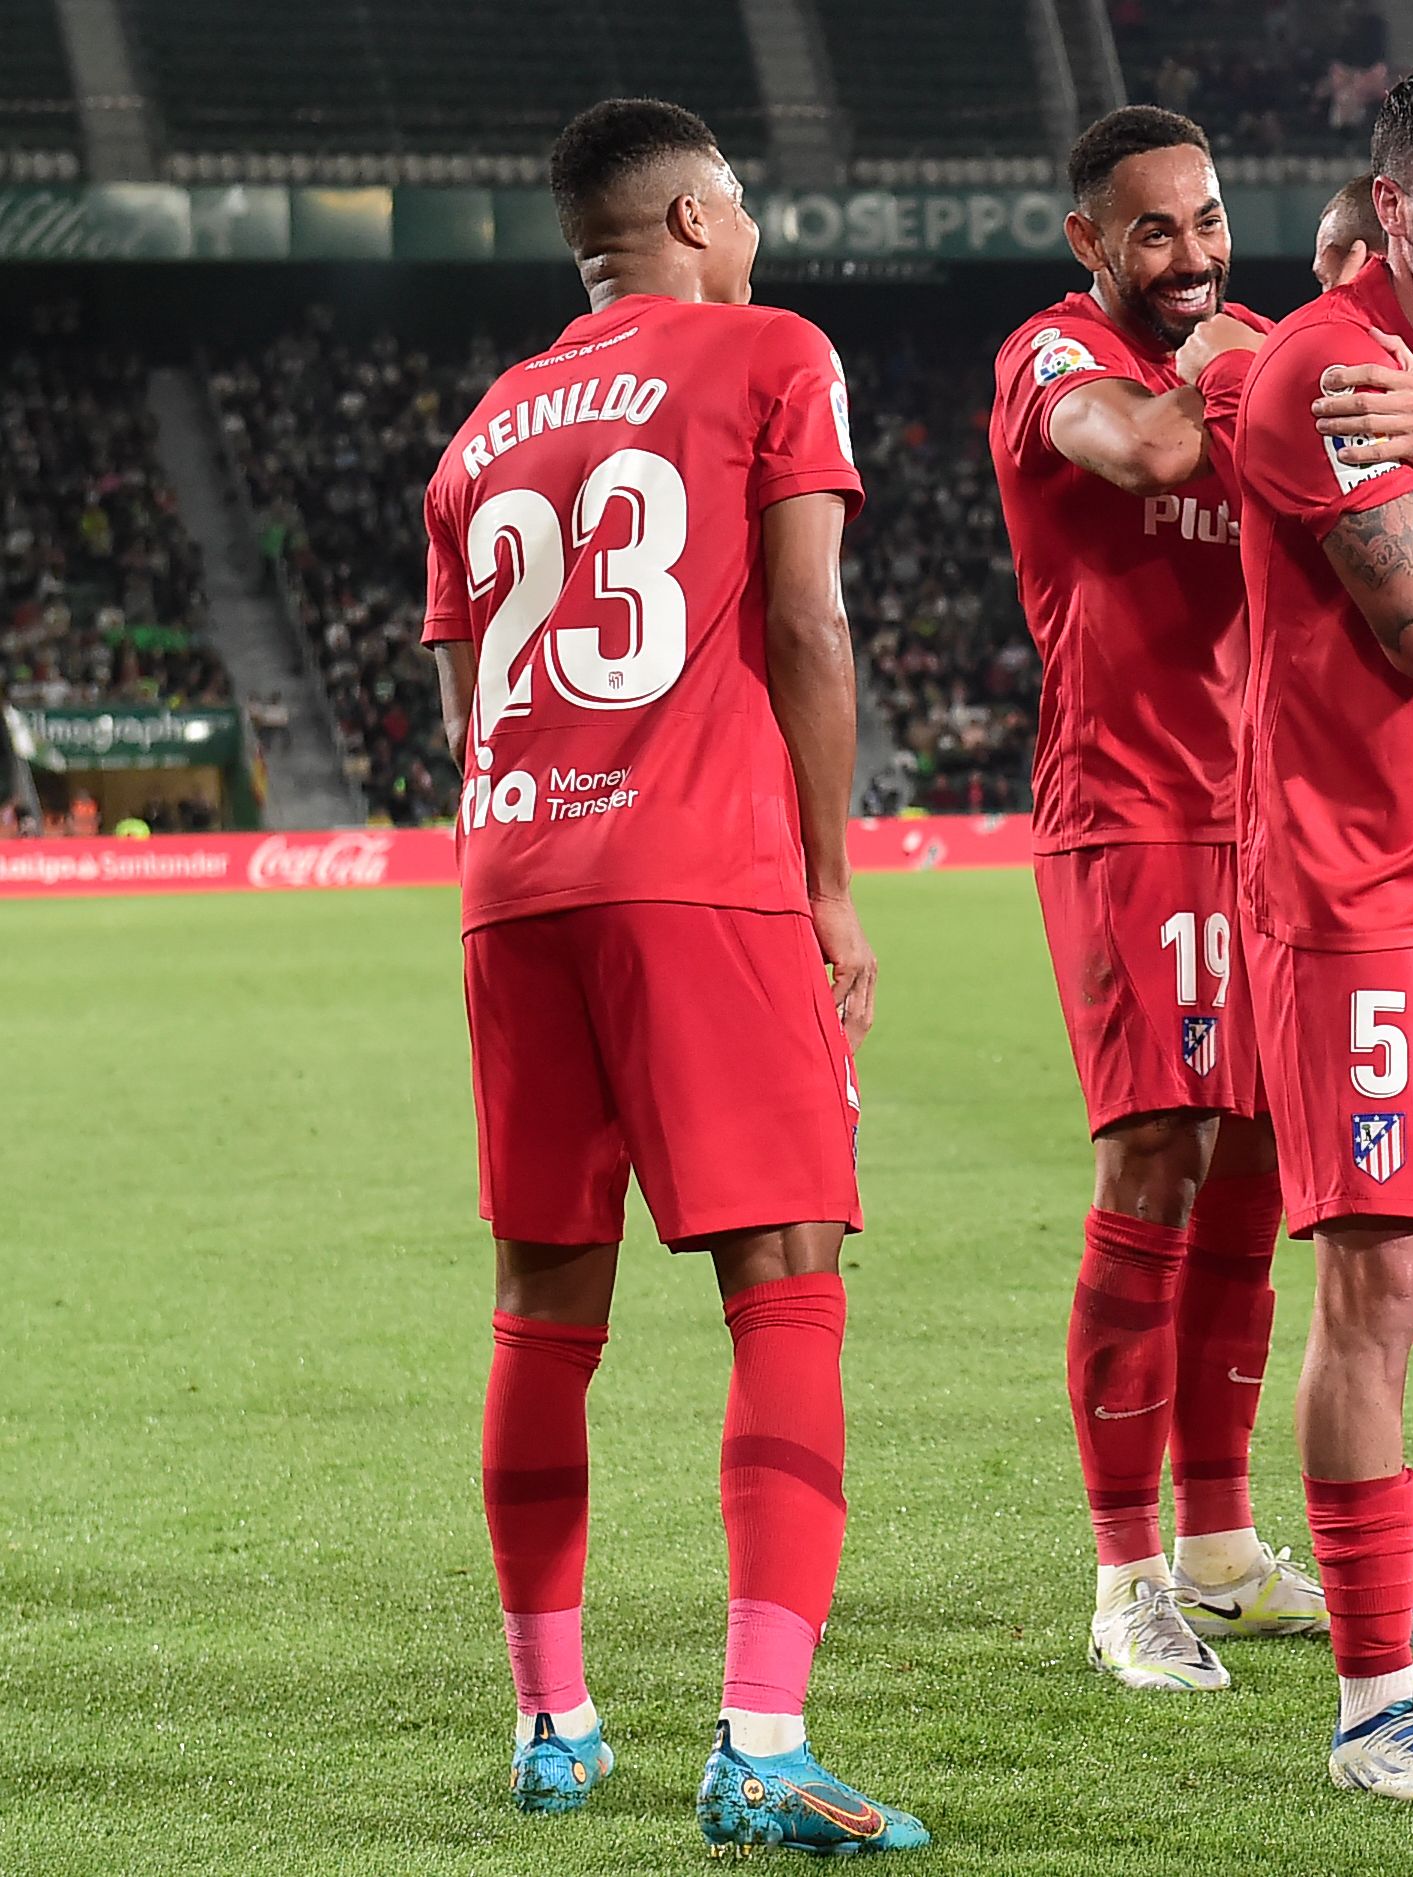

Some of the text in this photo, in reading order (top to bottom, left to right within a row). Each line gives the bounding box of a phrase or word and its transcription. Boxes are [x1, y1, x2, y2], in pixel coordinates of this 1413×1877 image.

[579, 345, 596, 356] DE
[462, 373, 668, 480] REINILDO
[467, 449, 687, 753] 23
[461, 746, 538, 836] ria
[546, 789, 640, 821] Transfer
[550, 765, 633, 792] Money
[102, 850, 229, 881] Santander
[1160, 912, 1230, 1008] 19
[1350, 989, 1409, 1099] 5
